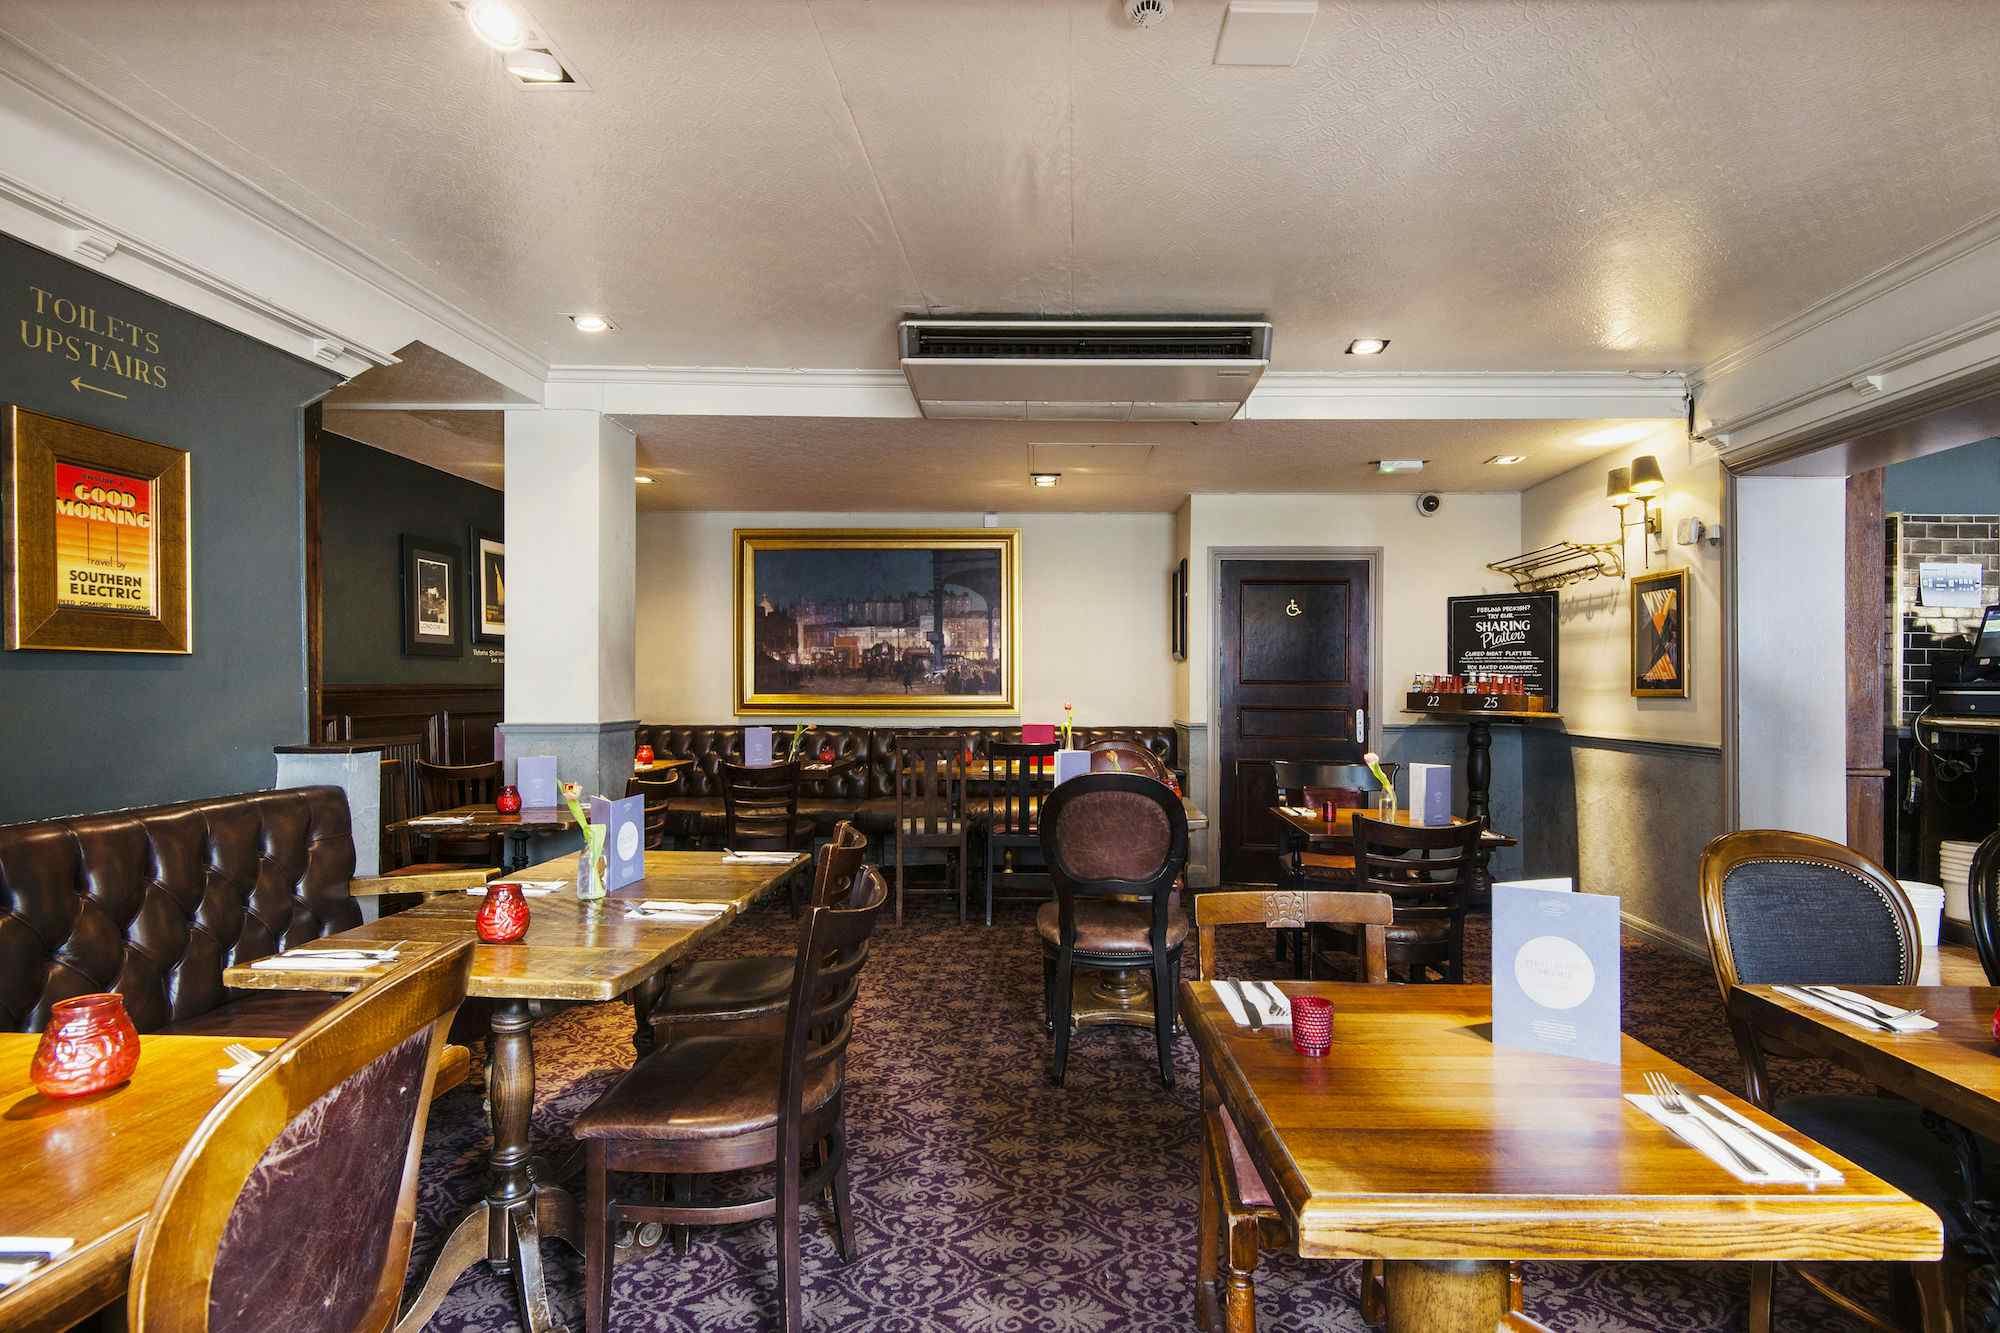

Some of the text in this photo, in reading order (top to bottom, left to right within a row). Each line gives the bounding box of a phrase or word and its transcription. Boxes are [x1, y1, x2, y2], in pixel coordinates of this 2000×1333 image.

[30, 286, 160, 354] TOILETS
[20, 319, 168, 389] UPSTAIRS
[74, 482, 136, 508] GOOD
[56, 499, 150, 528] MORNING
[70, 570, 142, 587] SOUTHERN
[70, 583, 141, 600] ELECTRIC
[1475, 620, 1531, 632] SHARING
[1480, 630, 1526, 648] Platters
[1427, 695, 1440, 707] 22
[1483, 696, 1498, 708] 25
